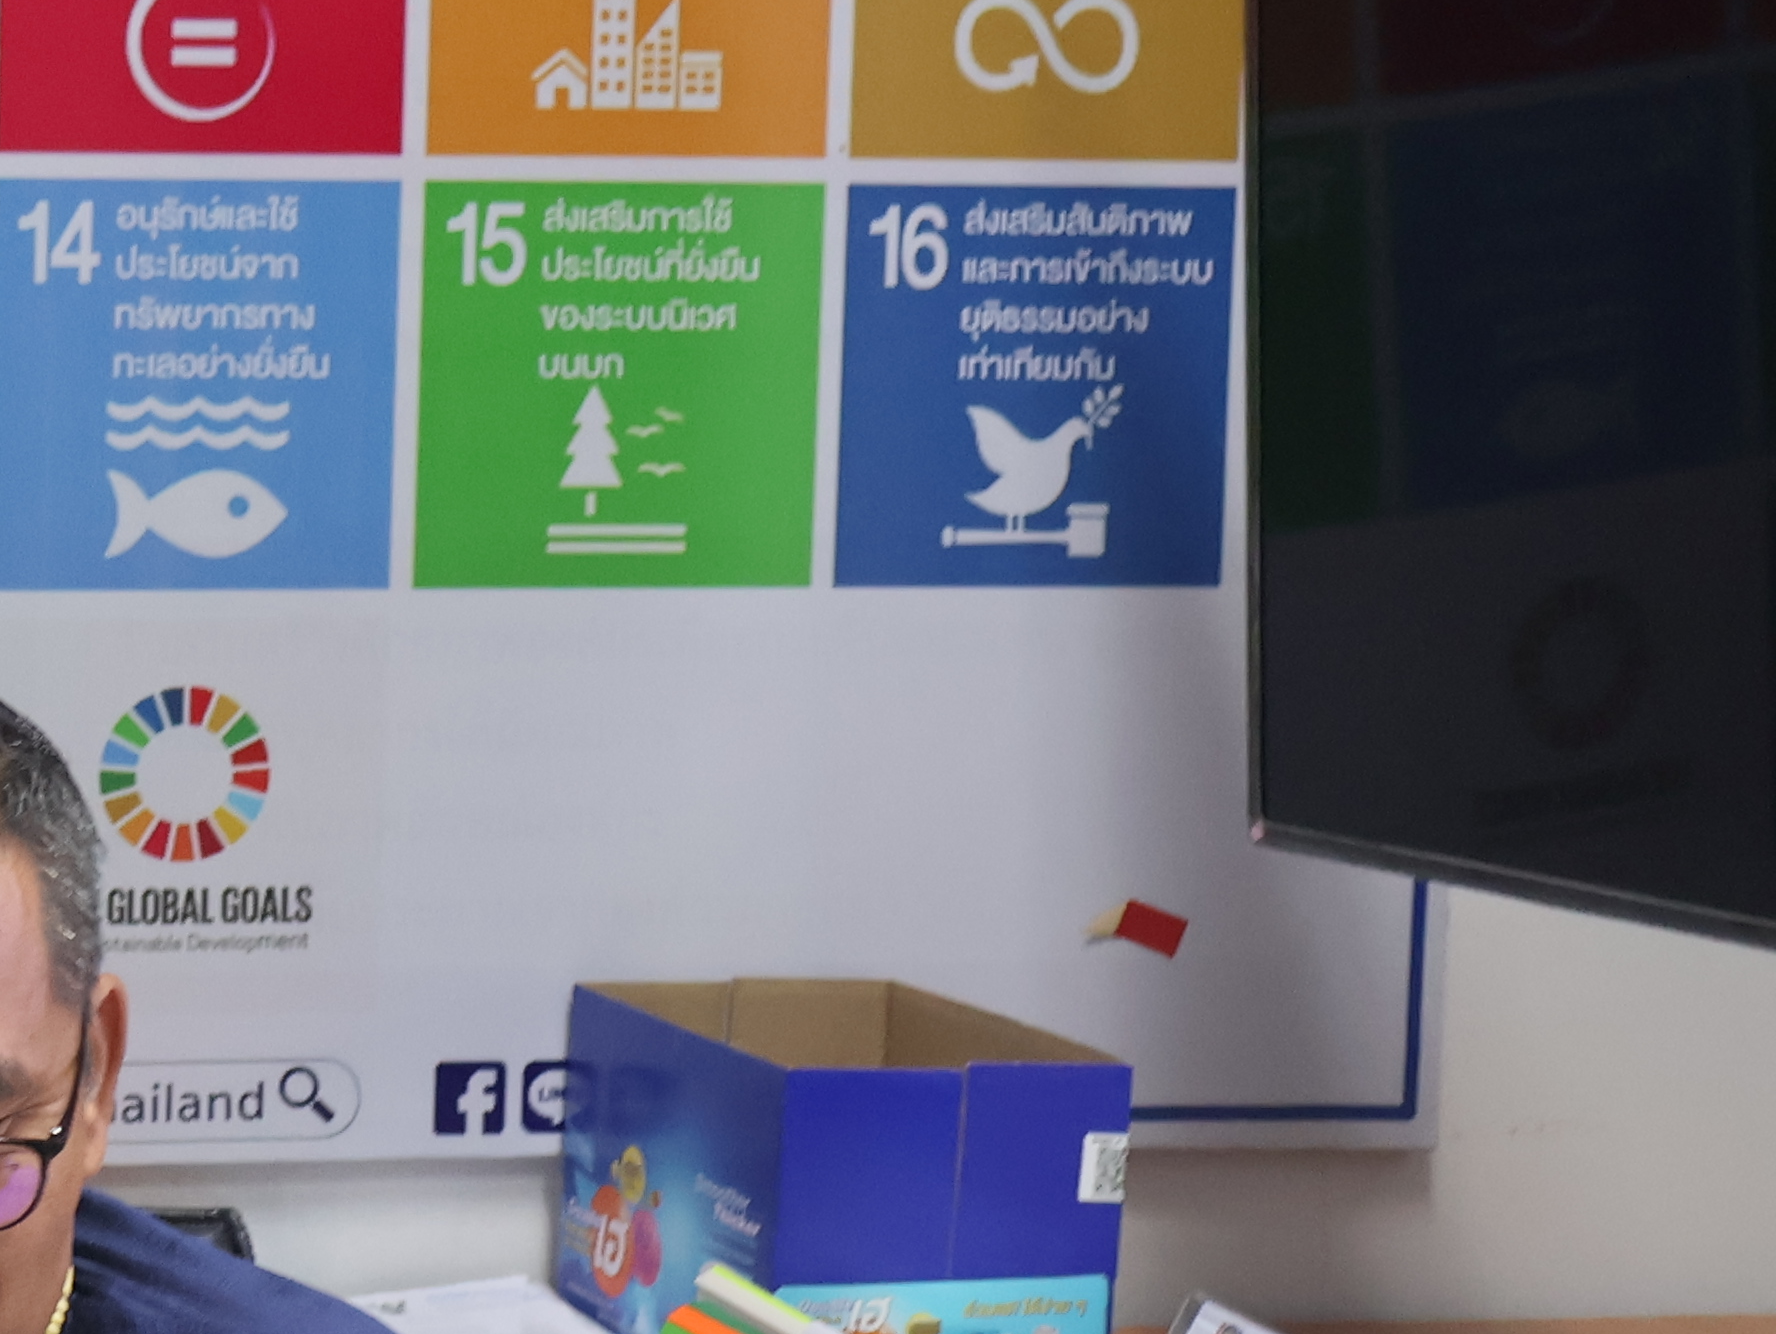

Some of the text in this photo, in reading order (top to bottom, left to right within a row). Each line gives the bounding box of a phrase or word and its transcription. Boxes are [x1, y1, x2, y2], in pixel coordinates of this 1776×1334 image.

[17, 200, 101, 285] 14
[115, 245, 298, 282] ประโยชน์จาก
[446, 202, 528, 287] 15
[868, 203, 949, 290] 16
[113, 297, 315, 333] ทรัพยากรทาง
[113, 340, 331, 381] ทะเลอย่างยั่งยืน
[107, 885, 313, 925] GLOBAL GOALS
[112, 1080, 266, 1124] ailand
